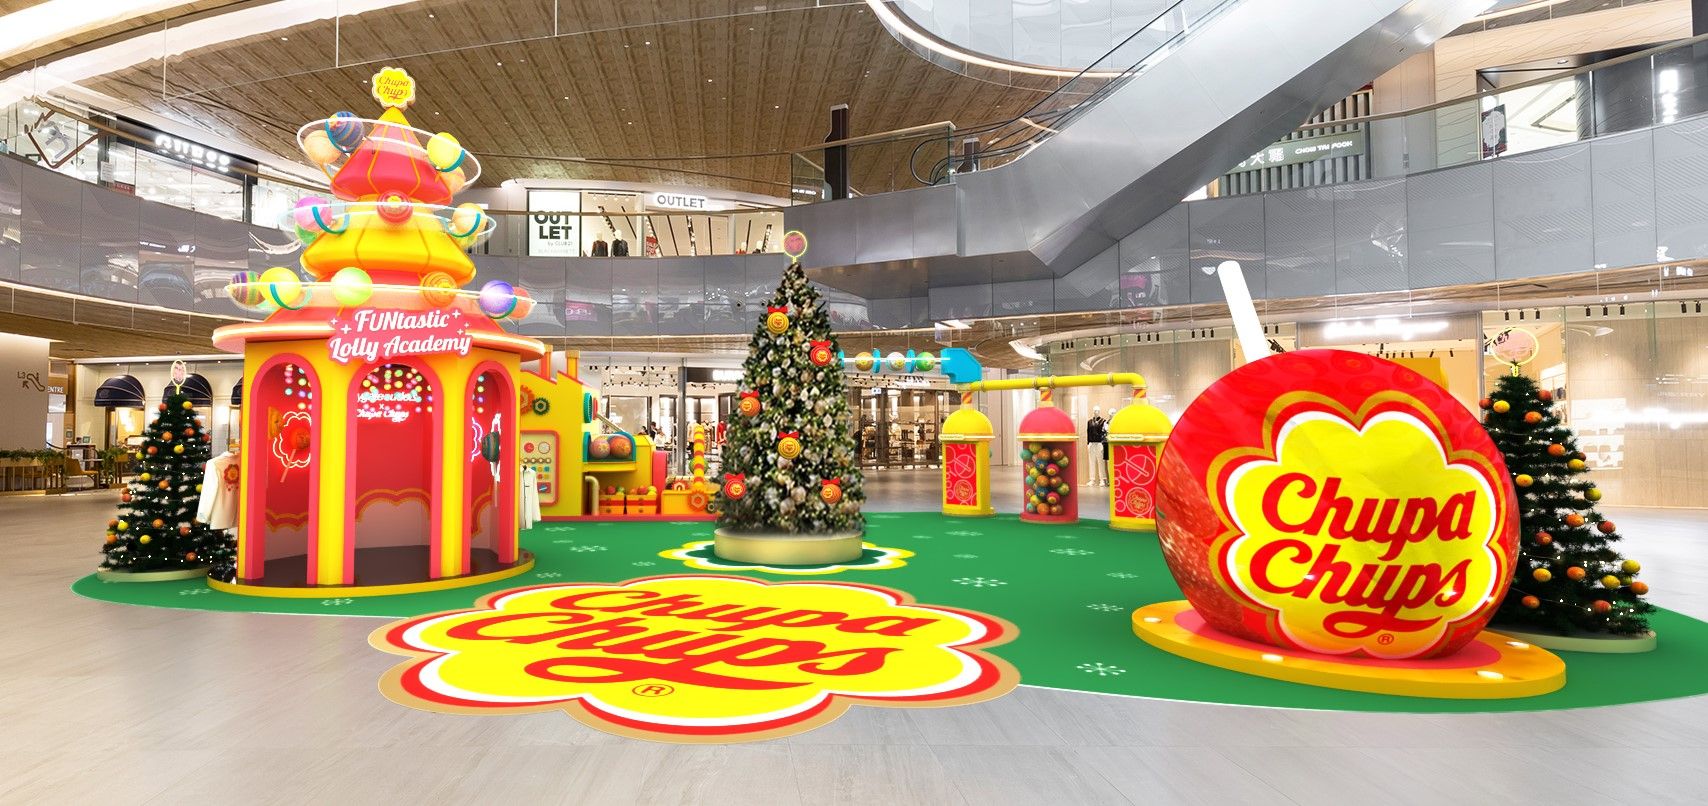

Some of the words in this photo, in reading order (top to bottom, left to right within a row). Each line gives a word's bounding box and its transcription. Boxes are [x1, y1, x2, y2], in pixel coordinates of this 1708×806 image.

[379, 76, 409, 87] Chupa
[377, 86, 408, 100] Chups
[657, 195, 705, 209] OUTLET
[534, 210, 572, 225] OUT
[539, 225, 572, 240] LET
[354, 309, 450, 332] FUNtastic
[329, 337, 380, 363] Lolly
[383, 334, 471, 356] Academy
[17, 371, 26, 379] L3
[1262, 472, 1477, 562] Chupa
[1249, 538, 1473, 639] Chups
[549, 589, 941, 638] Chupa
[445, 612, 904, 690] Chups
